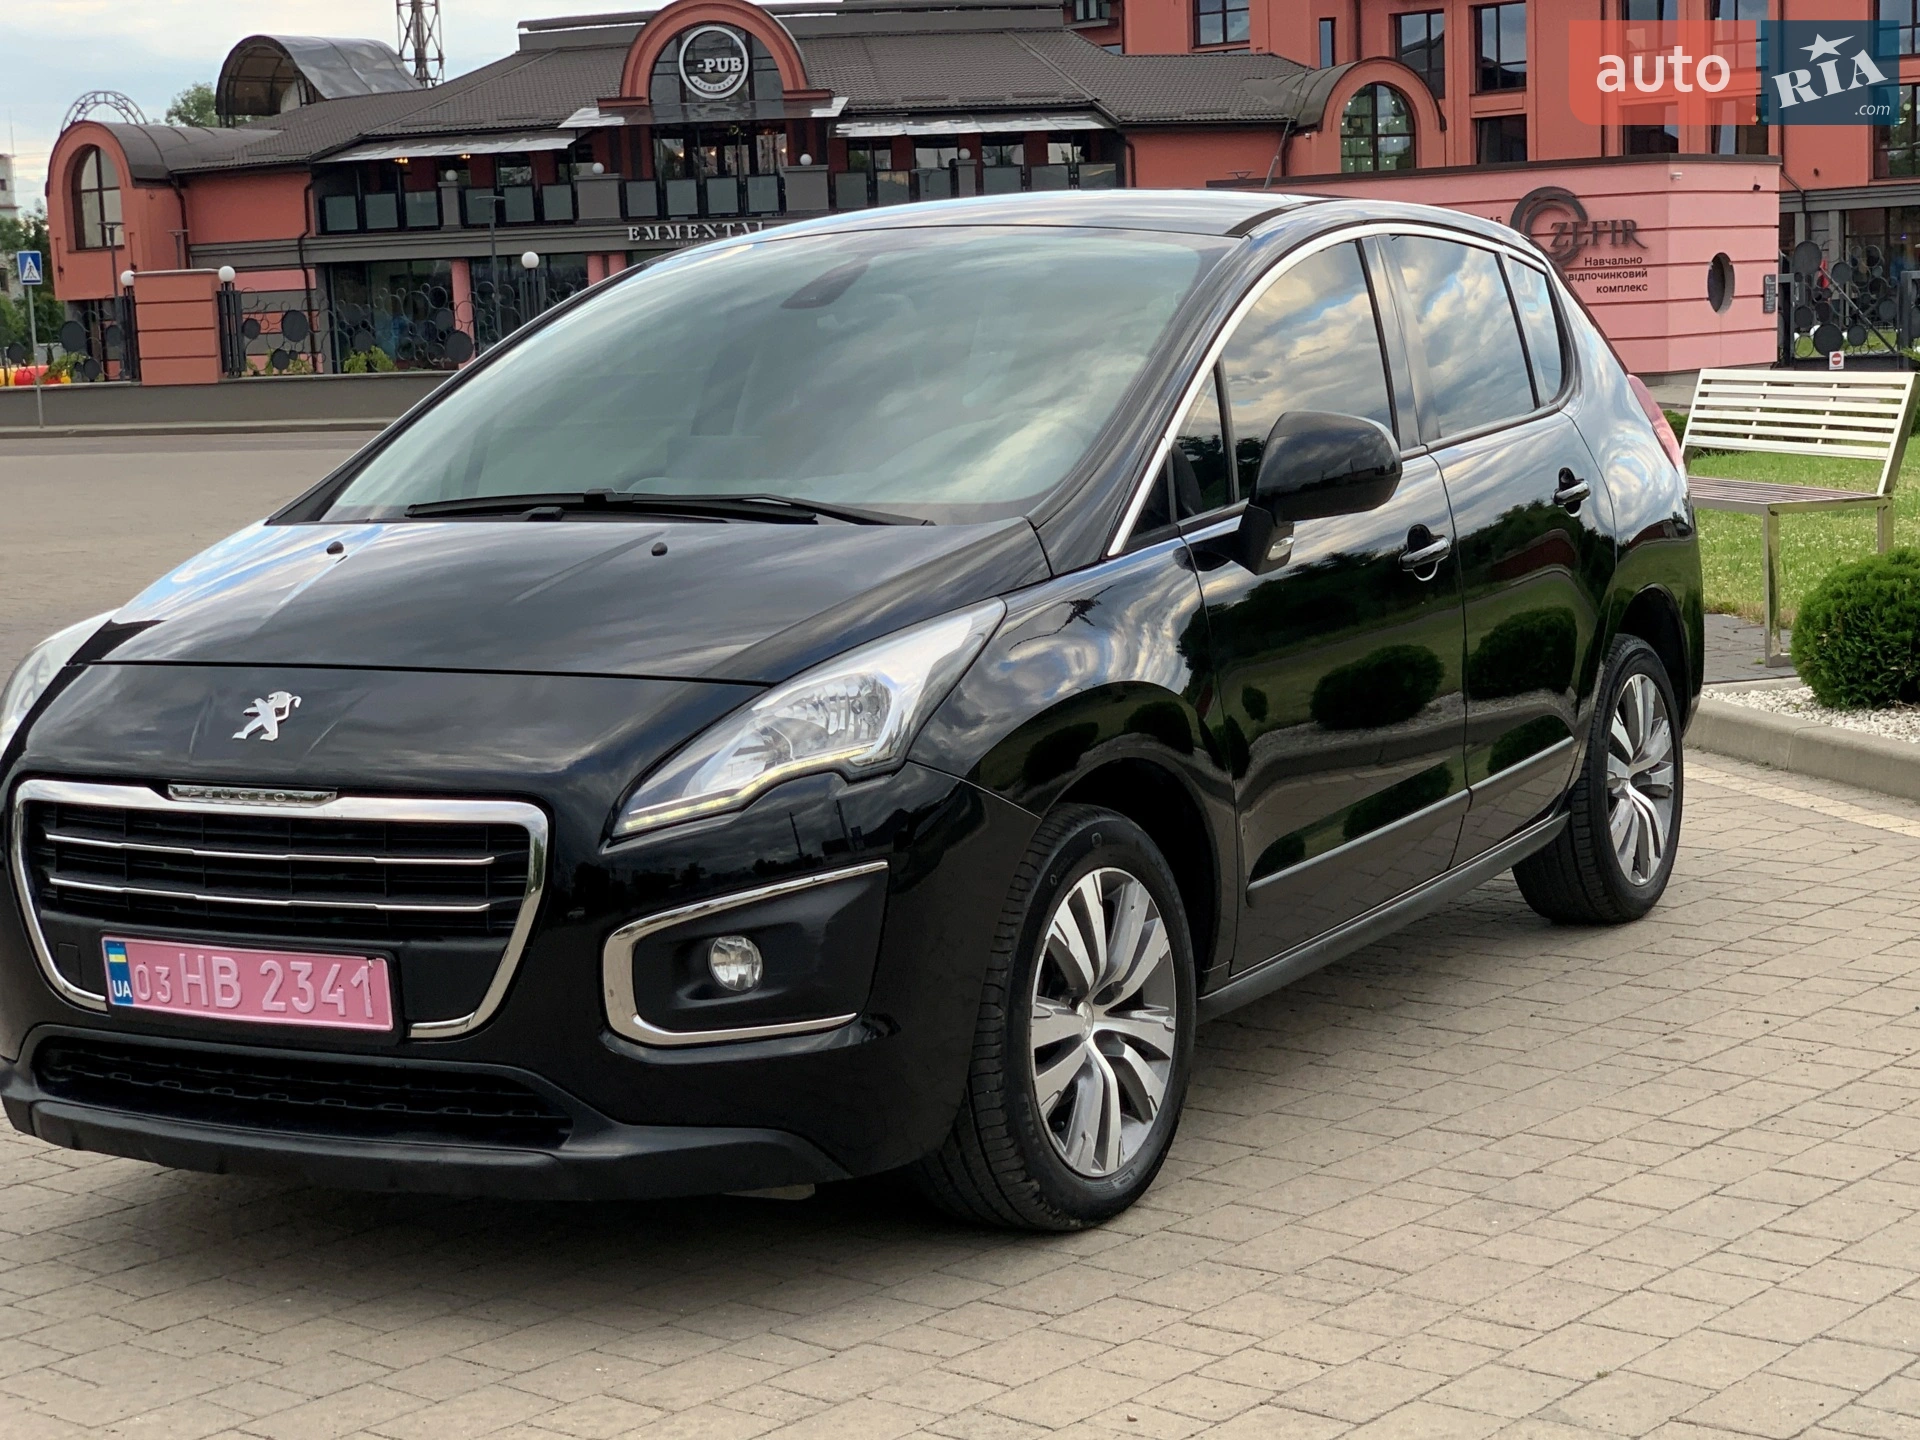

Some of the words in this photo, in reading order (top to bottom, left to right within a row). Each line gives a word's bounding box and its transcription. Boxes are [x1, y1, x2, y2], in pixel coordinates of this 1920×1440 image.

[697, 57, 742, 73] -PUB
[1584, 256, 1643, 267] Навчально
[1569, 268, 1648, 282] відпочинковий
[1596, 283, 1648, 294] комплекс
[188, 788, 304, 803] PEUGEOT
[112, 980, 132, 998] UA
[134, 964, 172, 1003] 03
[179, 953, 242, 1009] HB
[259, 959, 374, 1019] 2341
